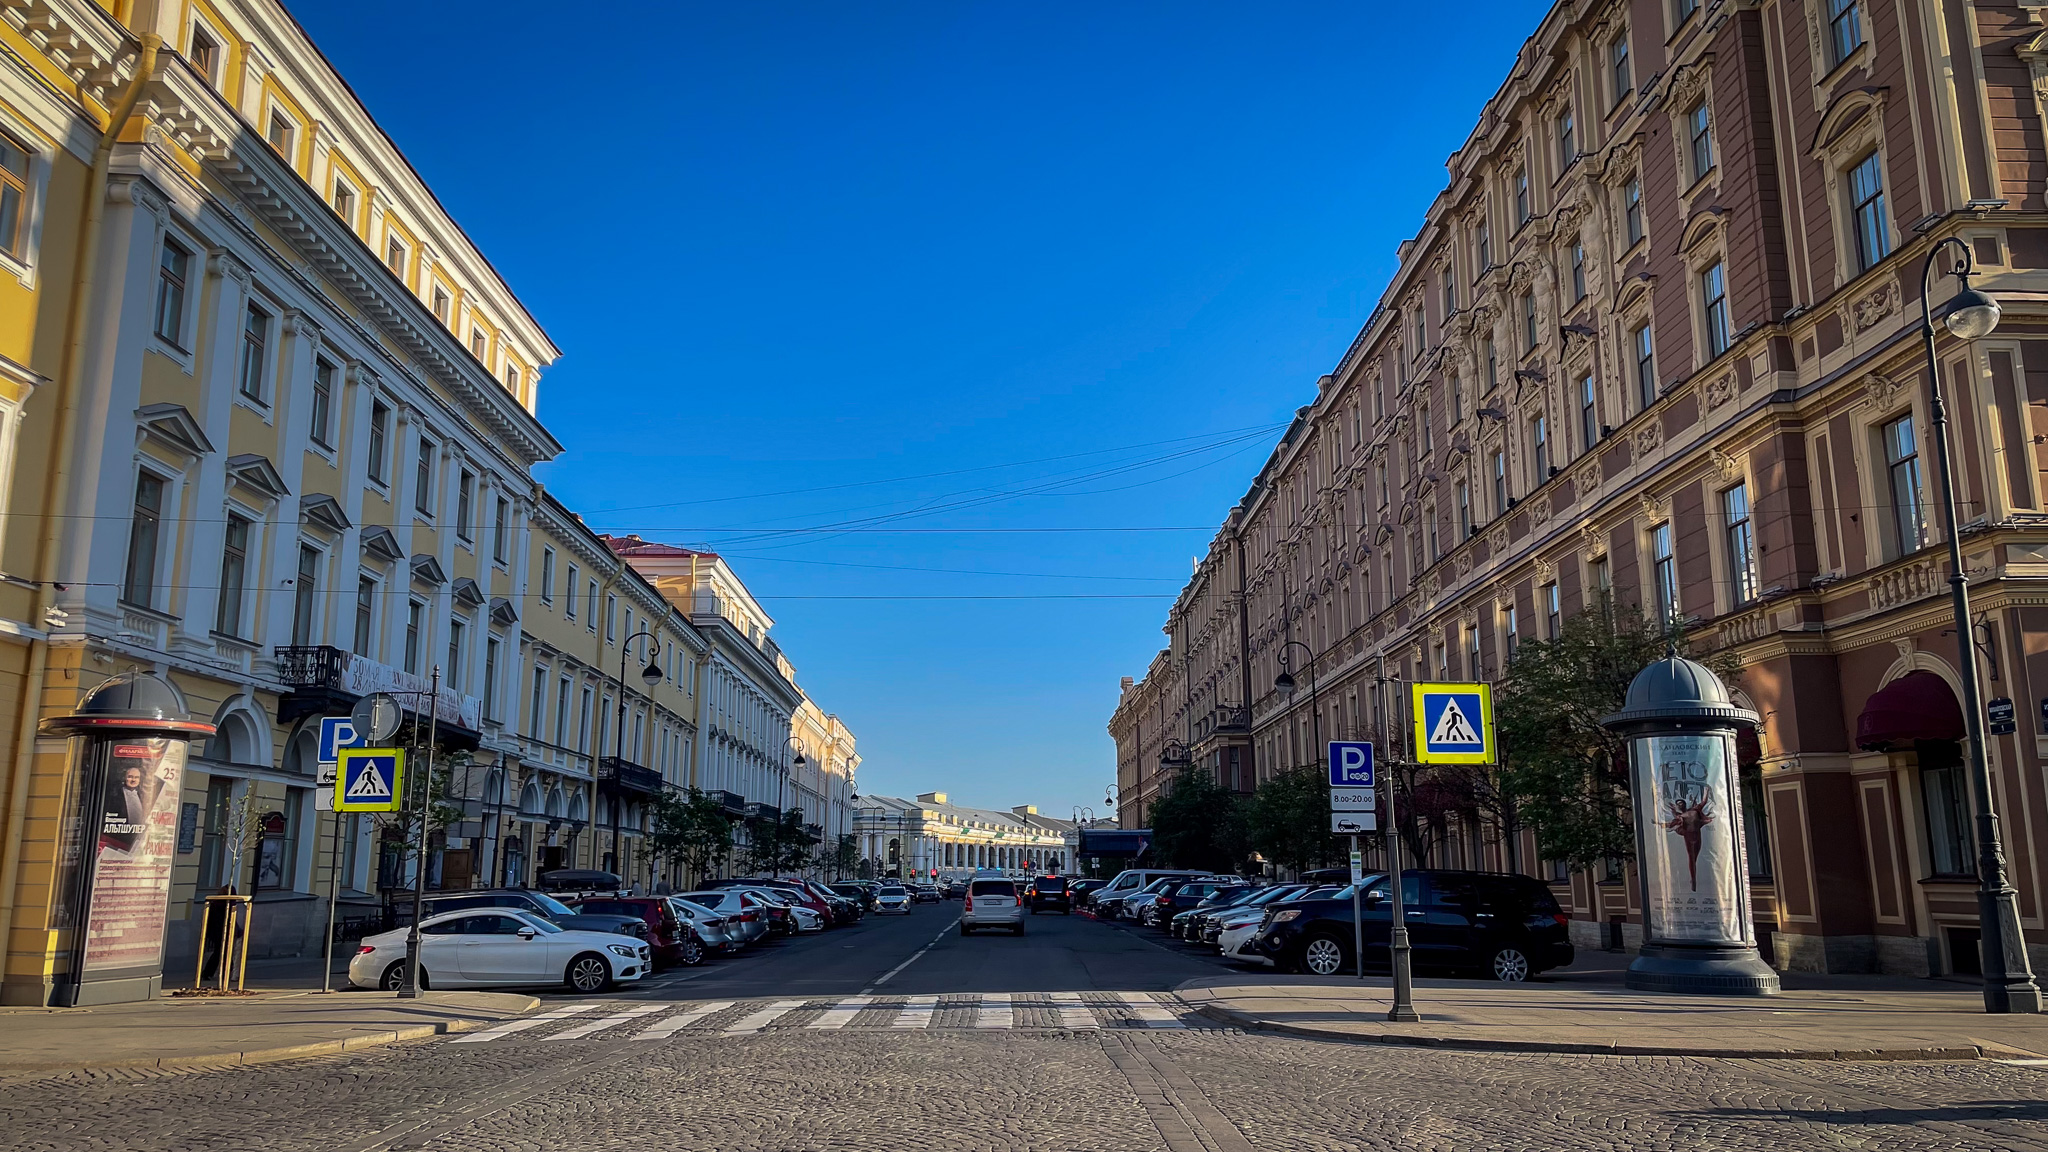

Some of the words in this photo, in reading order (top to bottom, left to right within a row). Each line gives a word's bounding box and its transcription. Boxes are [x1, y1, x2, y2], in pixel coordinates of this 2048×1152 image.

[332, 722, 359, 757] P
[1341, 747, 1365, 781] P
[163, 767, 175, 780] 25
[1334, 794, 1373, 803] 8.00-20.00
[103, 823, 146, 834] АЛЬТШУЛЕР
